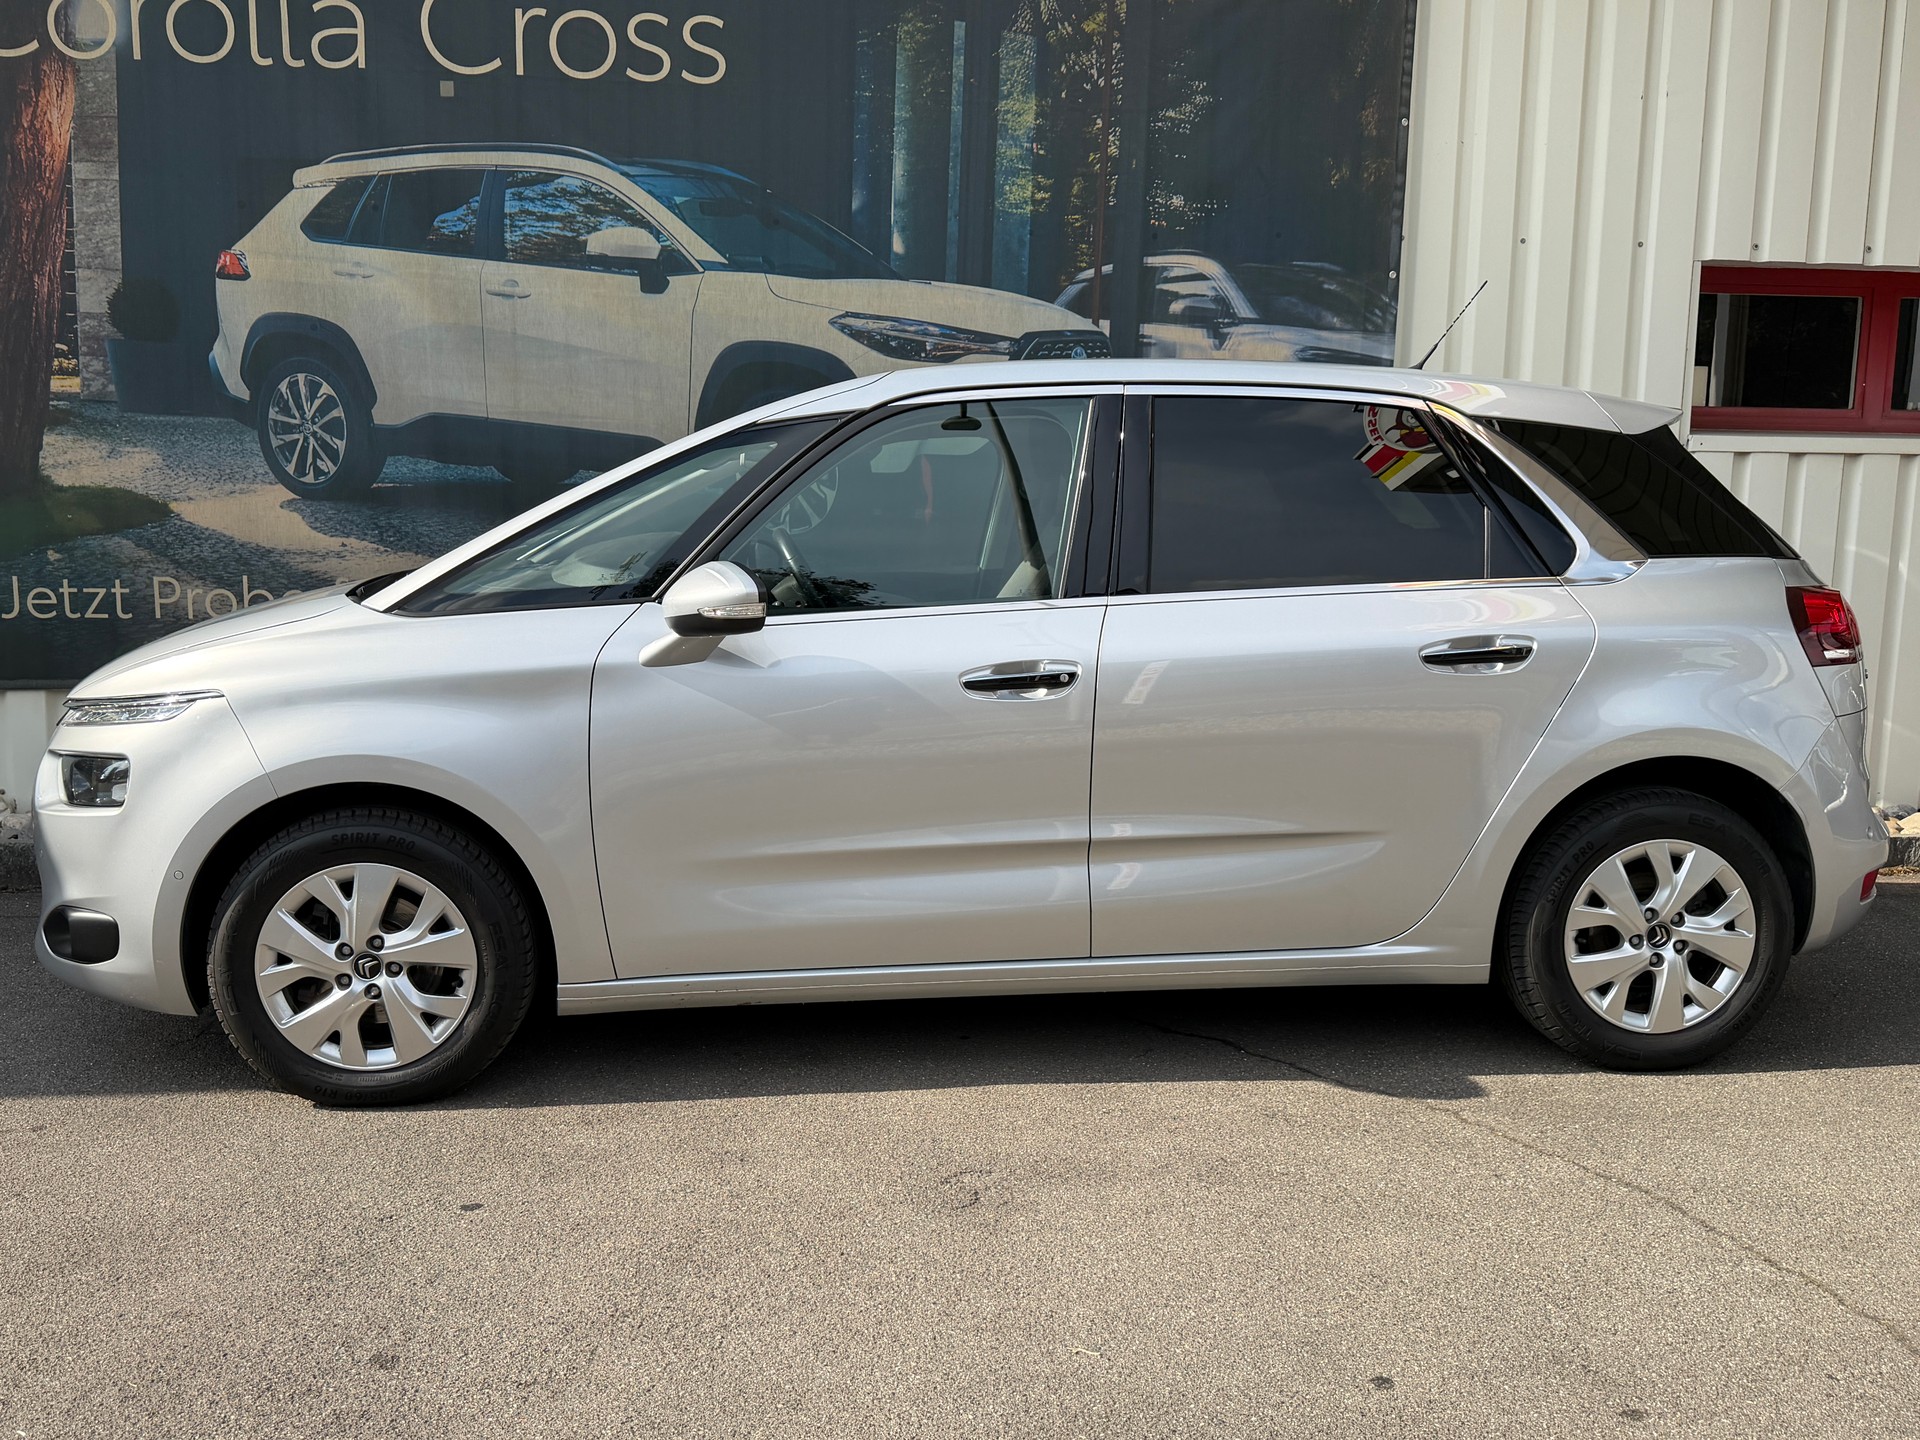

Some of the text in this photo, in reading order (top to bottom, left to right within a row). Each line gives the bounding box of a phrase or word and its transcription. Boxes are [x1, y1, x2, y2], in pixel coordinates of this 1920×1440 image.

[420, 0, 727, 85] Cross
[1, 575, 304, 619] Jetzt Prob
[331, 831, 417, 851] SPIRIT PRO
[1545, 840, 1595, 906] SPIRIT PRO
